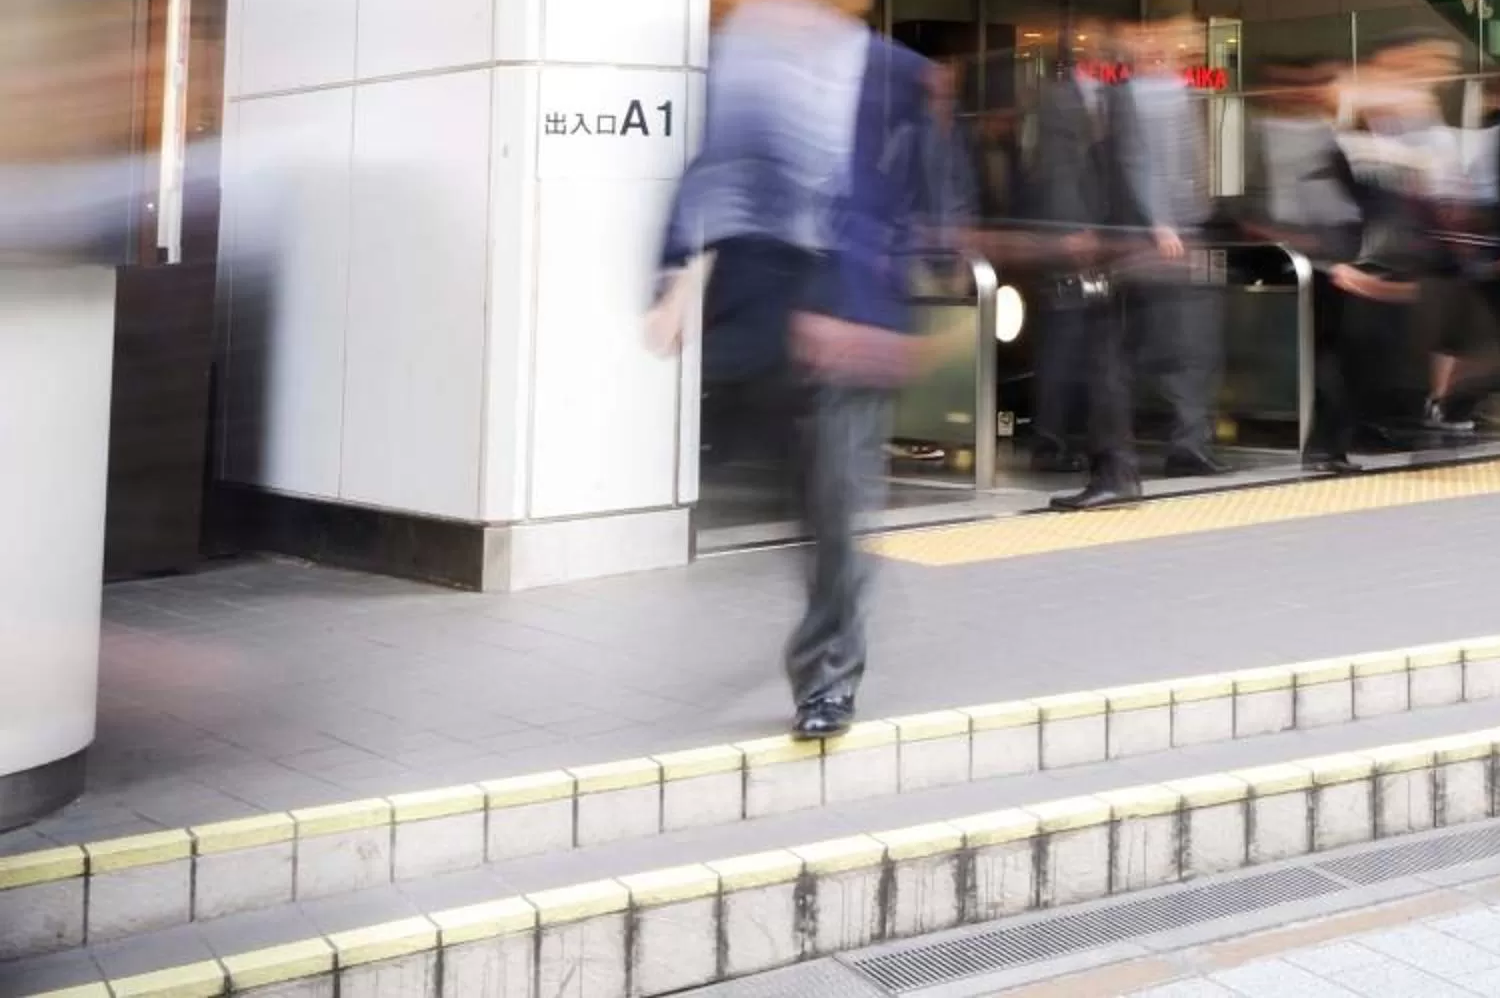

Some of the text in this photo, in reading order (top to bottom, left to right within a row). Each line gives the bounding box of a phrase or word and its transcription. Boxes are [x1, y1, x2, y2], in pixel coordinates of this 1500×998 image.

[545, 99, 672, 137] 出入口 A1
